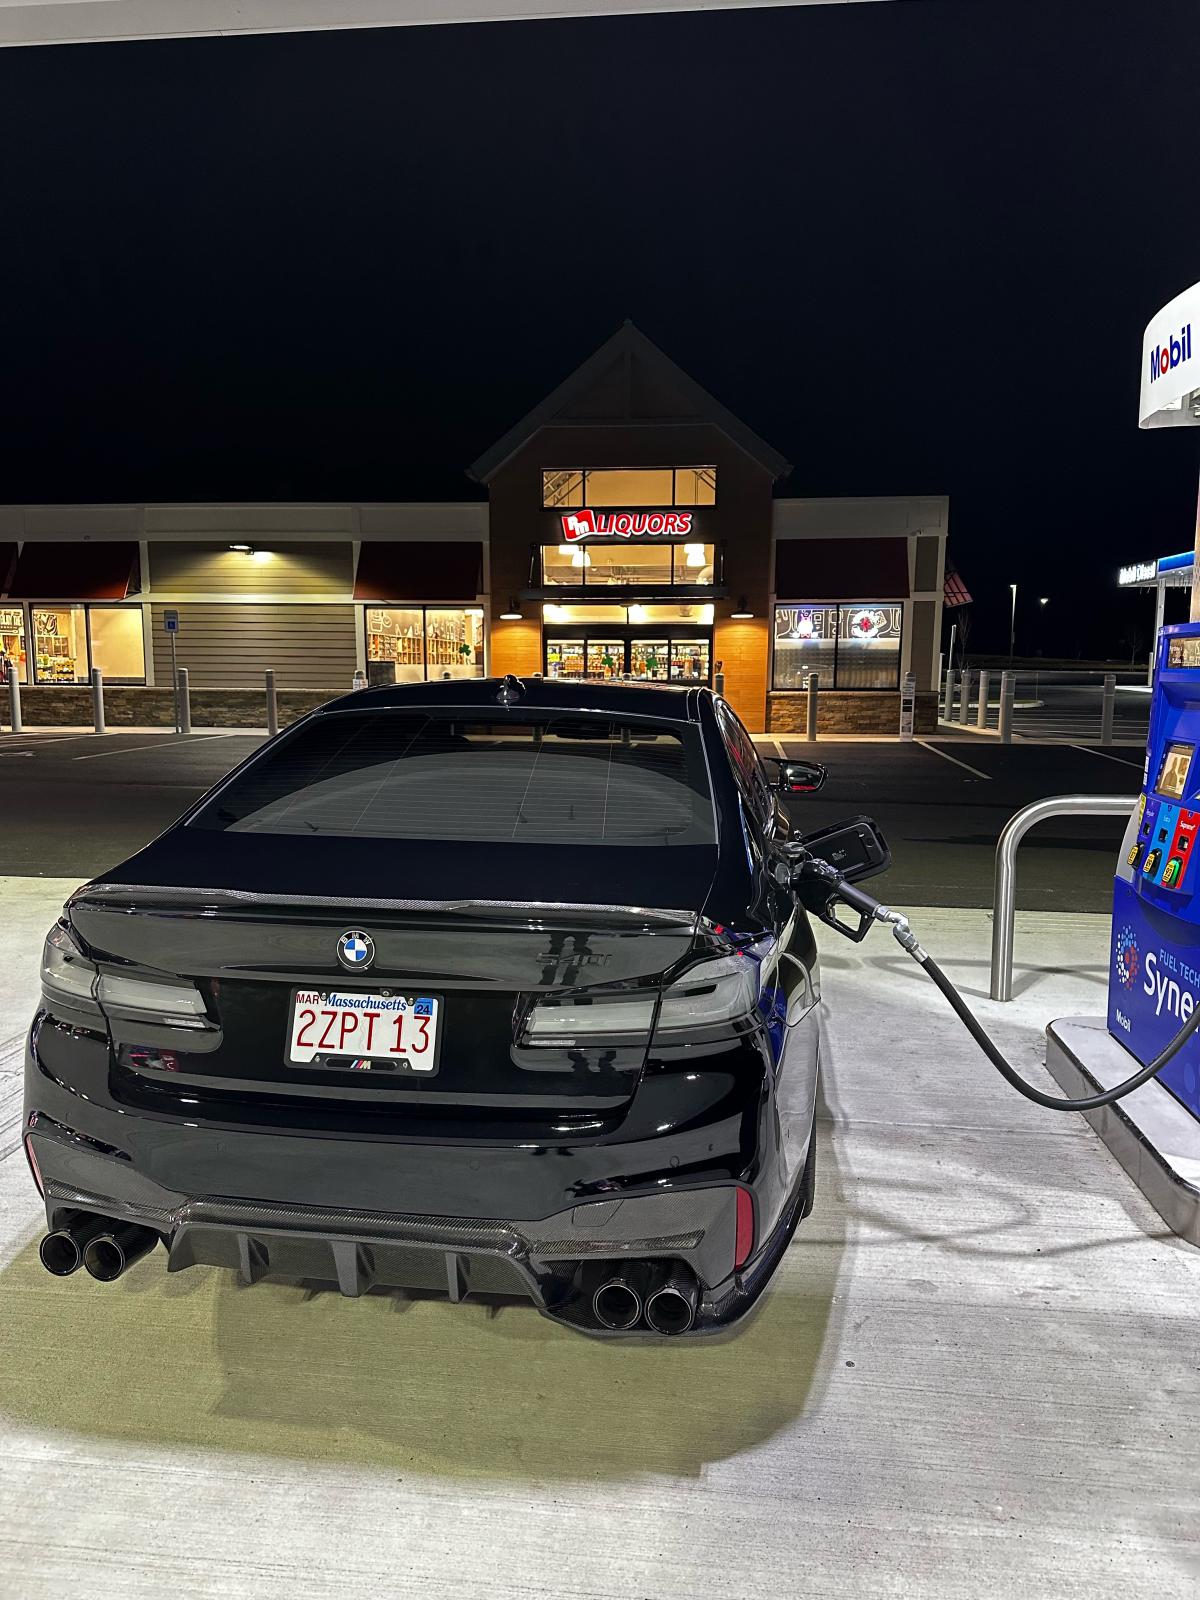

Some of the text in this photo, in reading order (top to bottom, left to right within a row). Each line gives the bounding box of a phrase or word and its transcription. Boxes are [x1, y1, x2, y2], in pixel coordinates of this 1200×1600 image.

[1150, 323, 1192, 384] Mobil
[596, 513, 692, 538] LIQUORS
[340, 932, 371, 945] BMW
[1159, 948, 1200, 989] FUEL TECH
[296, 993, 431, 1015] MAR Massachusetts 24
[1143, 952, 1200, 1032] Syne
[296, 1009, 431, 1054] 2ZPT 13
[1115, 1008, 1132, 1033] Mobil
